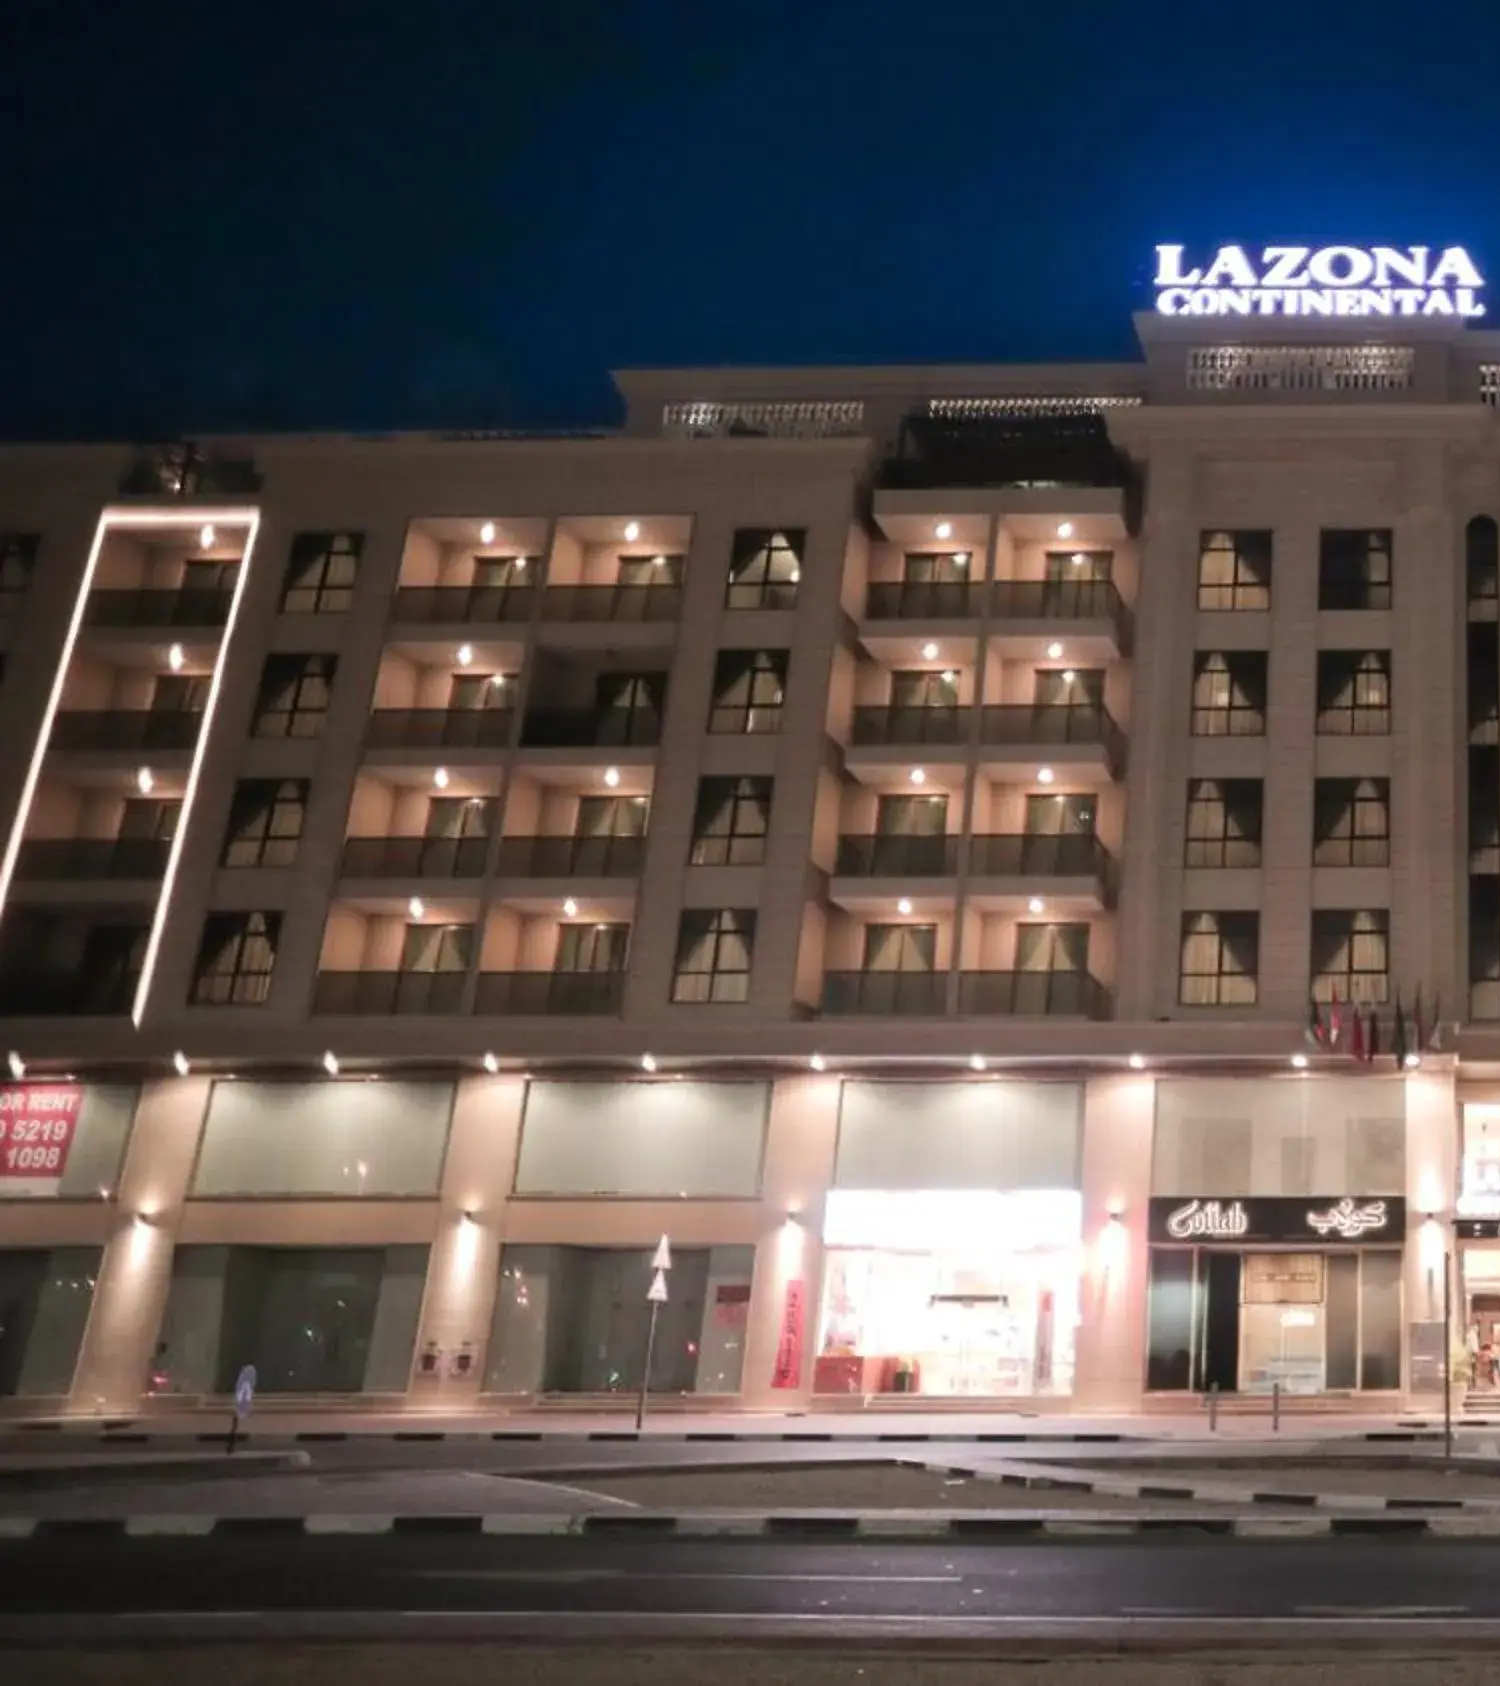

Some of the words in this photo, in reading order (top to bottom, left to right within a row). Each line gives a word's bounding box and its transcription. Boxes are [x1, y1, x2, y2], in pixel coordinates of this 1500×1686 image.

[1153, 243, 1485, 288] LAZONA
[1156, 287, 1487, 317] CONTINENTAL
[10, 1119, 69, 1142] 5219
